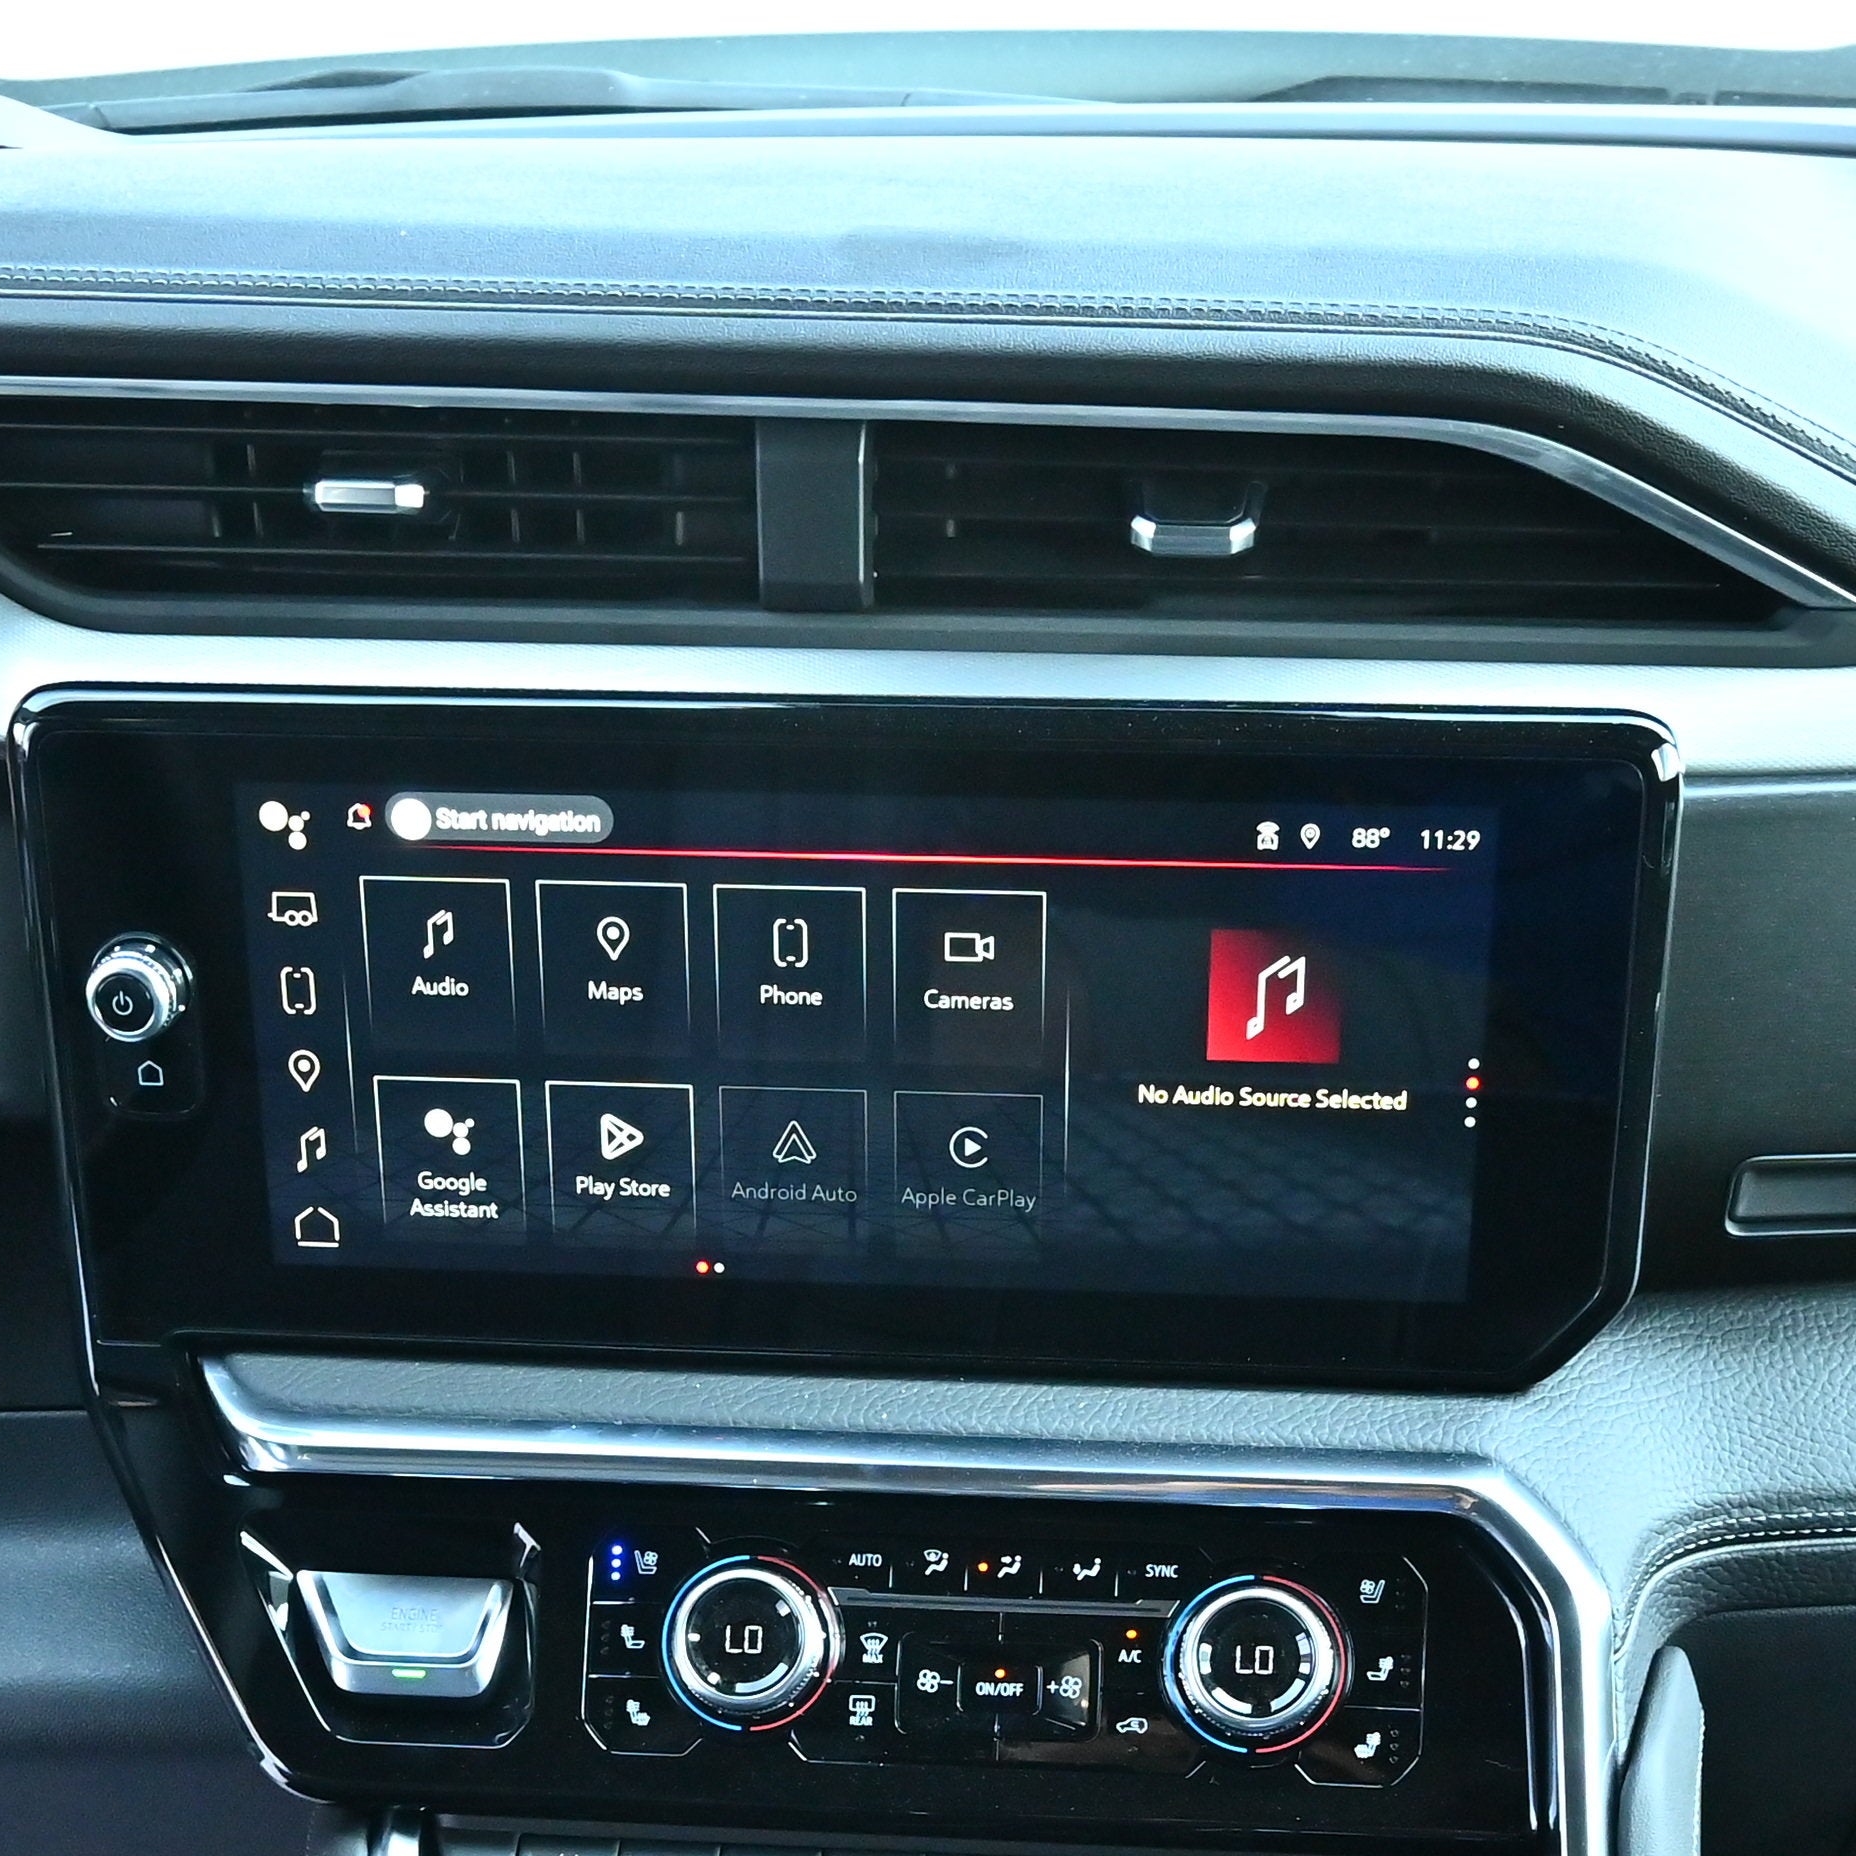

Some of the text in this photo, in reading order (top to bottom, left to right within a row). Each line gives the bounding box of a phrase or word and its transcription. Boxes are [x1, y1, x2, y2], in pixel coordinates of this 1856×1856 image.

[435, 807, 601, 837] Start navigation
[1420, 830, 1481, 851] 11:29
[411, 976, 469, 996] Audio
[588, 980, 644, 1005] Maps
[759, 984, 823, 1006] Phone
[923, 989, 1014, 1011] Cameras
[1138, 1083, 1408, 1112] No Audio Source Selected
[417, 1171, 487, 1197] Google
[576, 1175, 671, 1201] Play Store
[731, 1182, 857, 1203] Android Auto
[410, 1198, 499, 1220] Assistant
[901, 1187, 1037, 1213] Apple CarPlay
[848, 1553, 883, 1567] AUTO
[1145, 1564, 1179, 1578] SYNC
[725, 1625, 763, 1654] LO
[1118, 1650, 1142, 1663] A/C
[1235, 1645, 1274, 1675] LO
[975, 1682, 1024, 1697] ON/OFF
[849, 1716, 874, 1726] REAR
